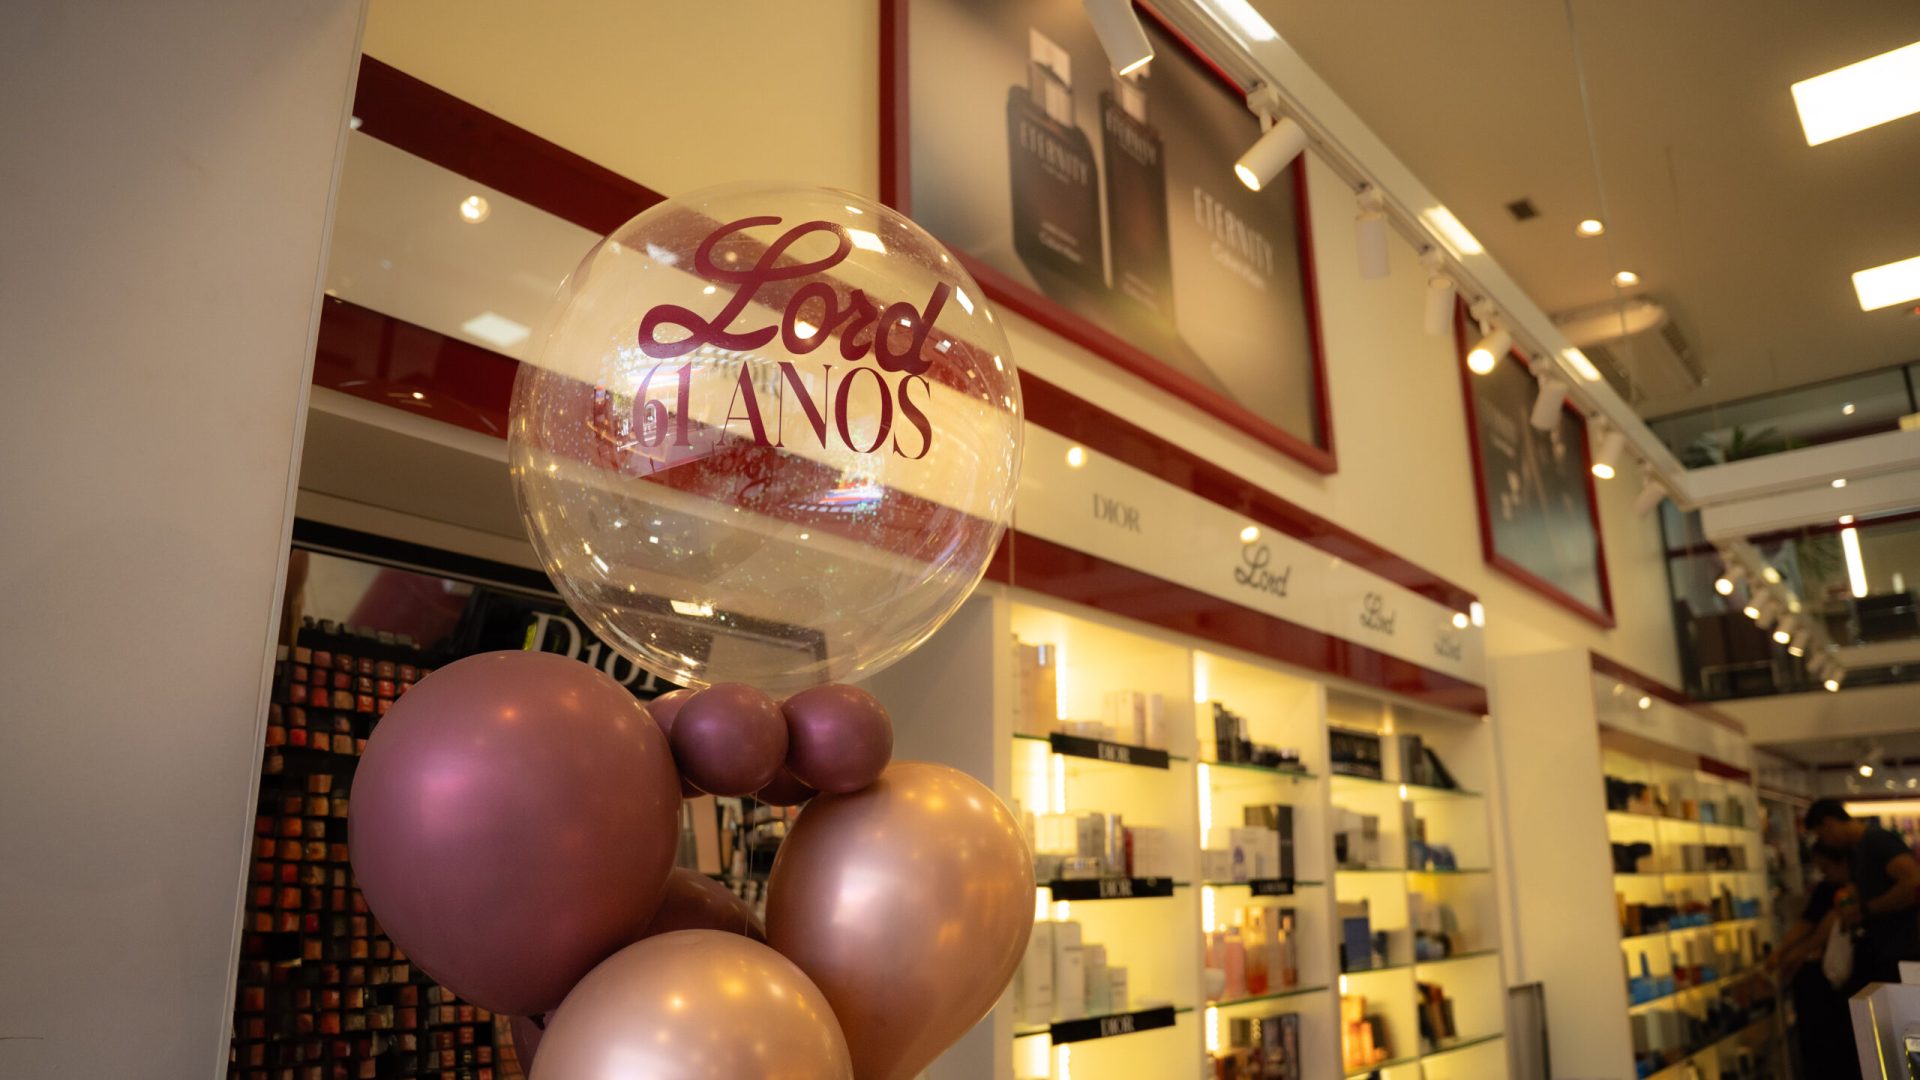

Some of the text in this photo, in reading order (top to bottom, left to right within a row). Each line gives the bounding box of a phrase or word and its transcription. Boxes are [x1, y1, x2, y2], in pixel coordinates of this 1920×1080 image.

[1193, 186, 1274, 278] ETERNITY
[638, 216, 951, 376] Lord
[632, 361, 693, 449] 61
[715, 360, 932, 460] ANOS
[1092, 493, 1142, 534] DIOR
[1234, 541, 1292, 598] Lord
[1099, 876, 1133, 898] DIOR
[1100, 1014, 1135, 1037] DIOR
